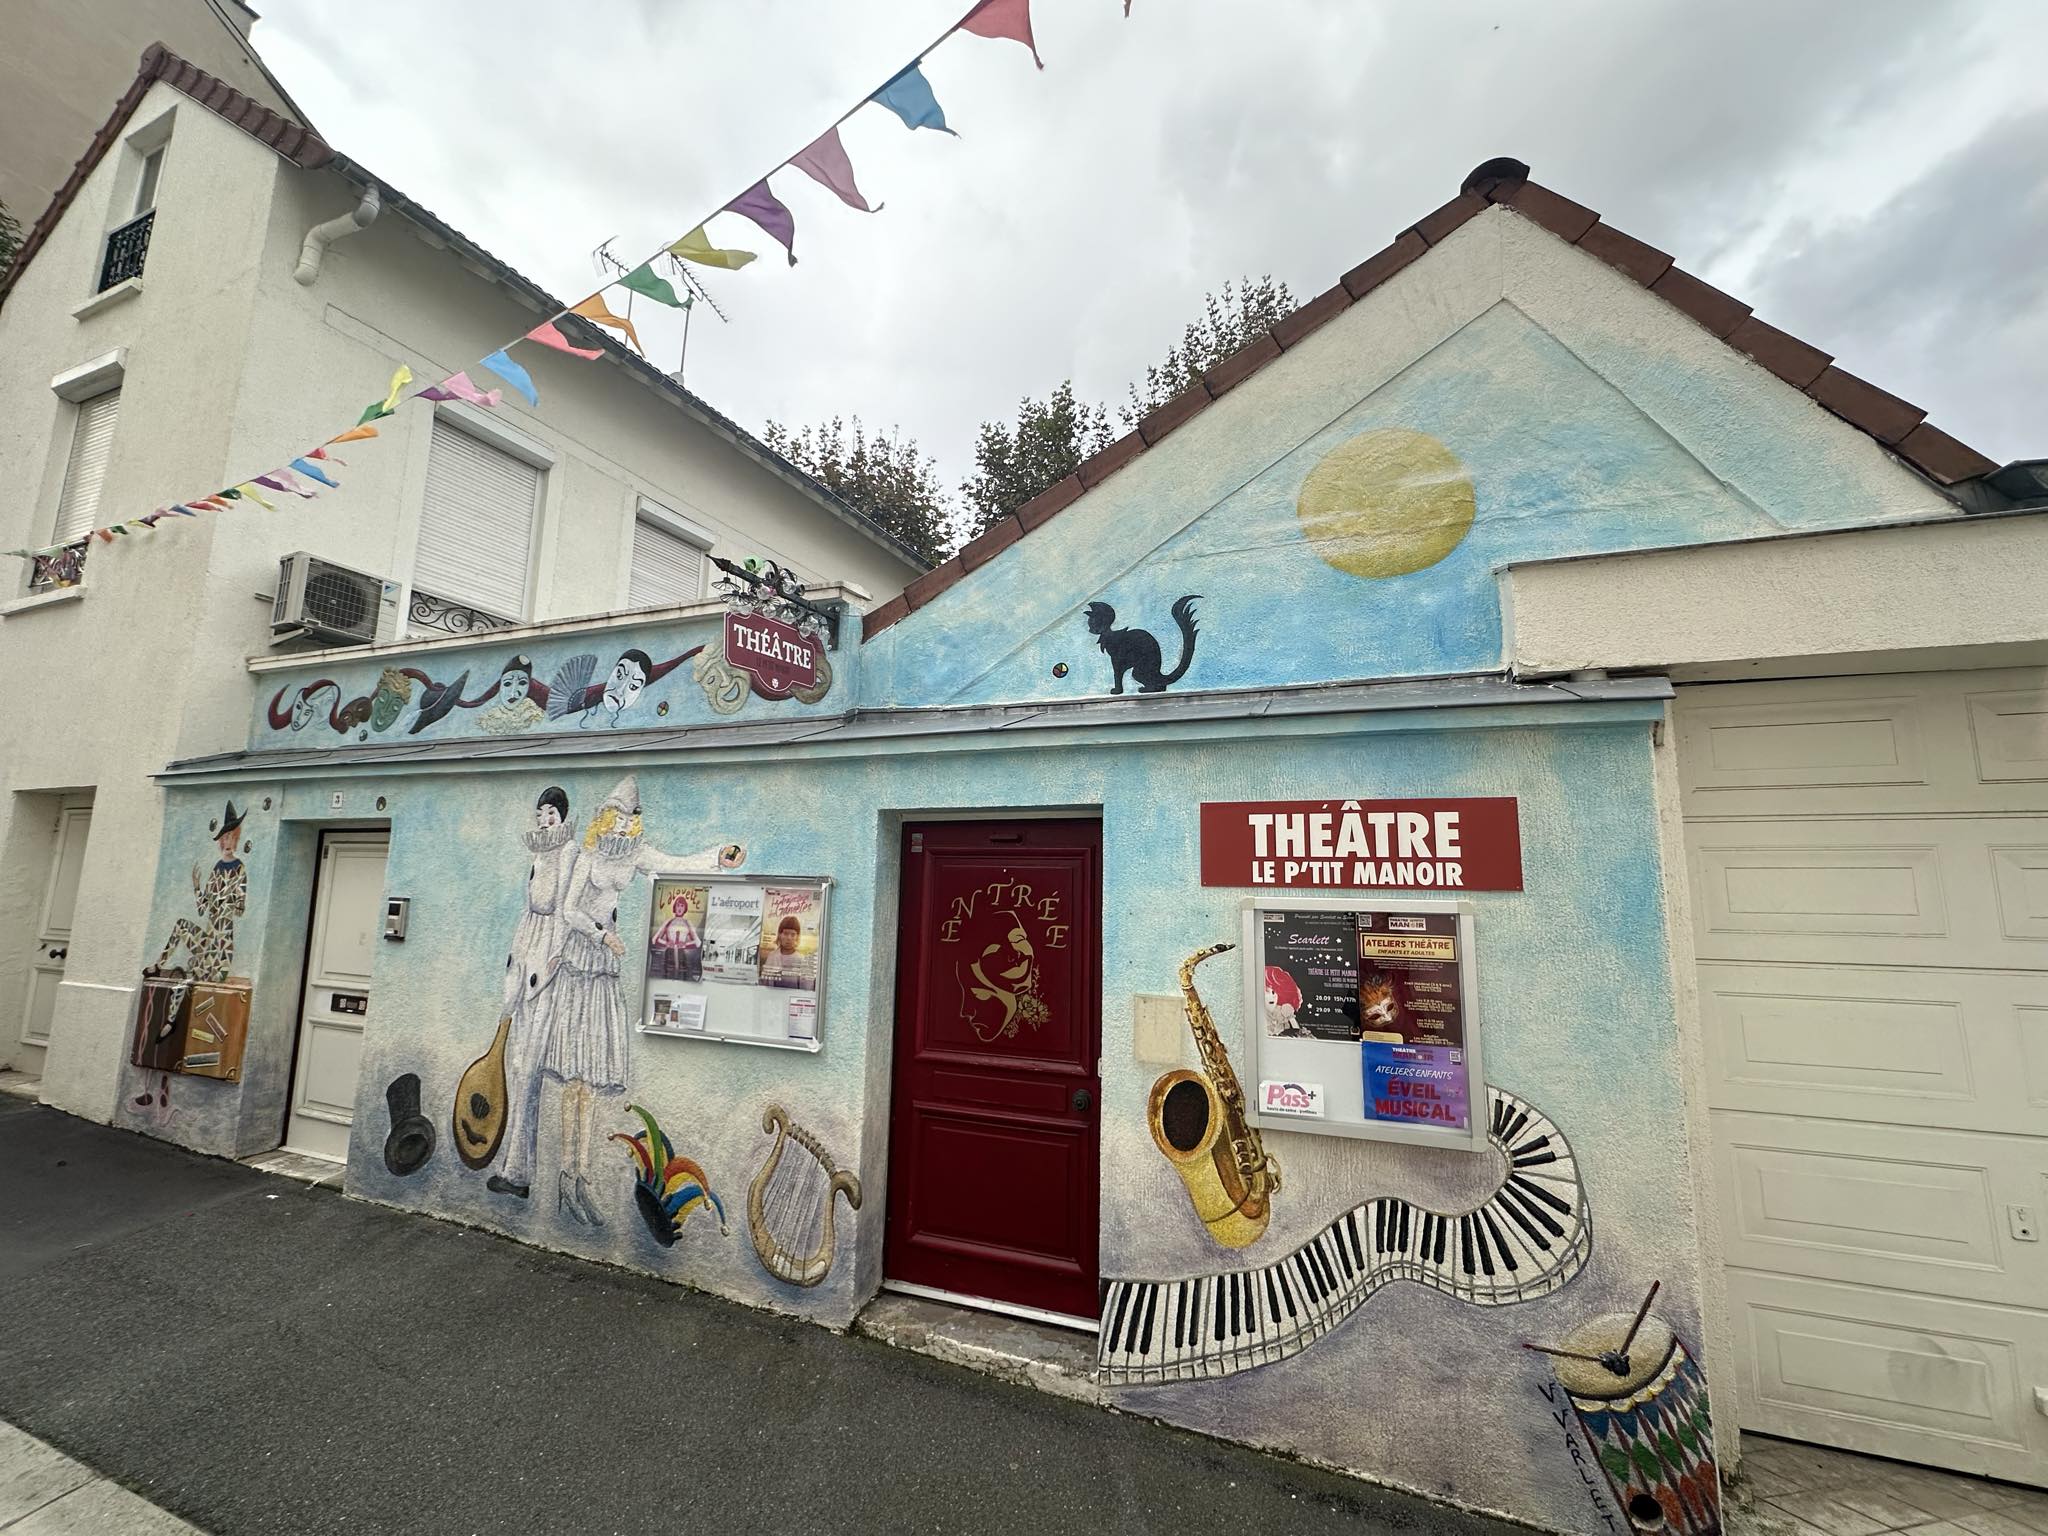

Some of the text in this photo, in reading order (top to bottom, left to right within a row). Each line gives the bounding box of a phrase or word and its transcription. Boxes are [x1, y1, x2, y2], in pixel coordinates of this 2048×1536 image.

[733, 623, 812, 670] THÉÂTRE
[1248, 800, 1462, 858] THÉÂTRE
[1252, 861, 1464, 887] LE P'TIT MANOIR
[711, 896, 760, 909] L'aéroport
[940, 877, 1069, 949] ENTRÉE
[1288, 933, 1330, 945] Scarlett
[1366, 939, 1450, 950] ATELIERS THÉÂTRE
[1375, 1065, 1454, 1080] ATELIERS ENFANTS
[1388, 1075, 1441, 1100] ÉVEIL
[1375, 1098, 1457, 1122] MUSICAL
